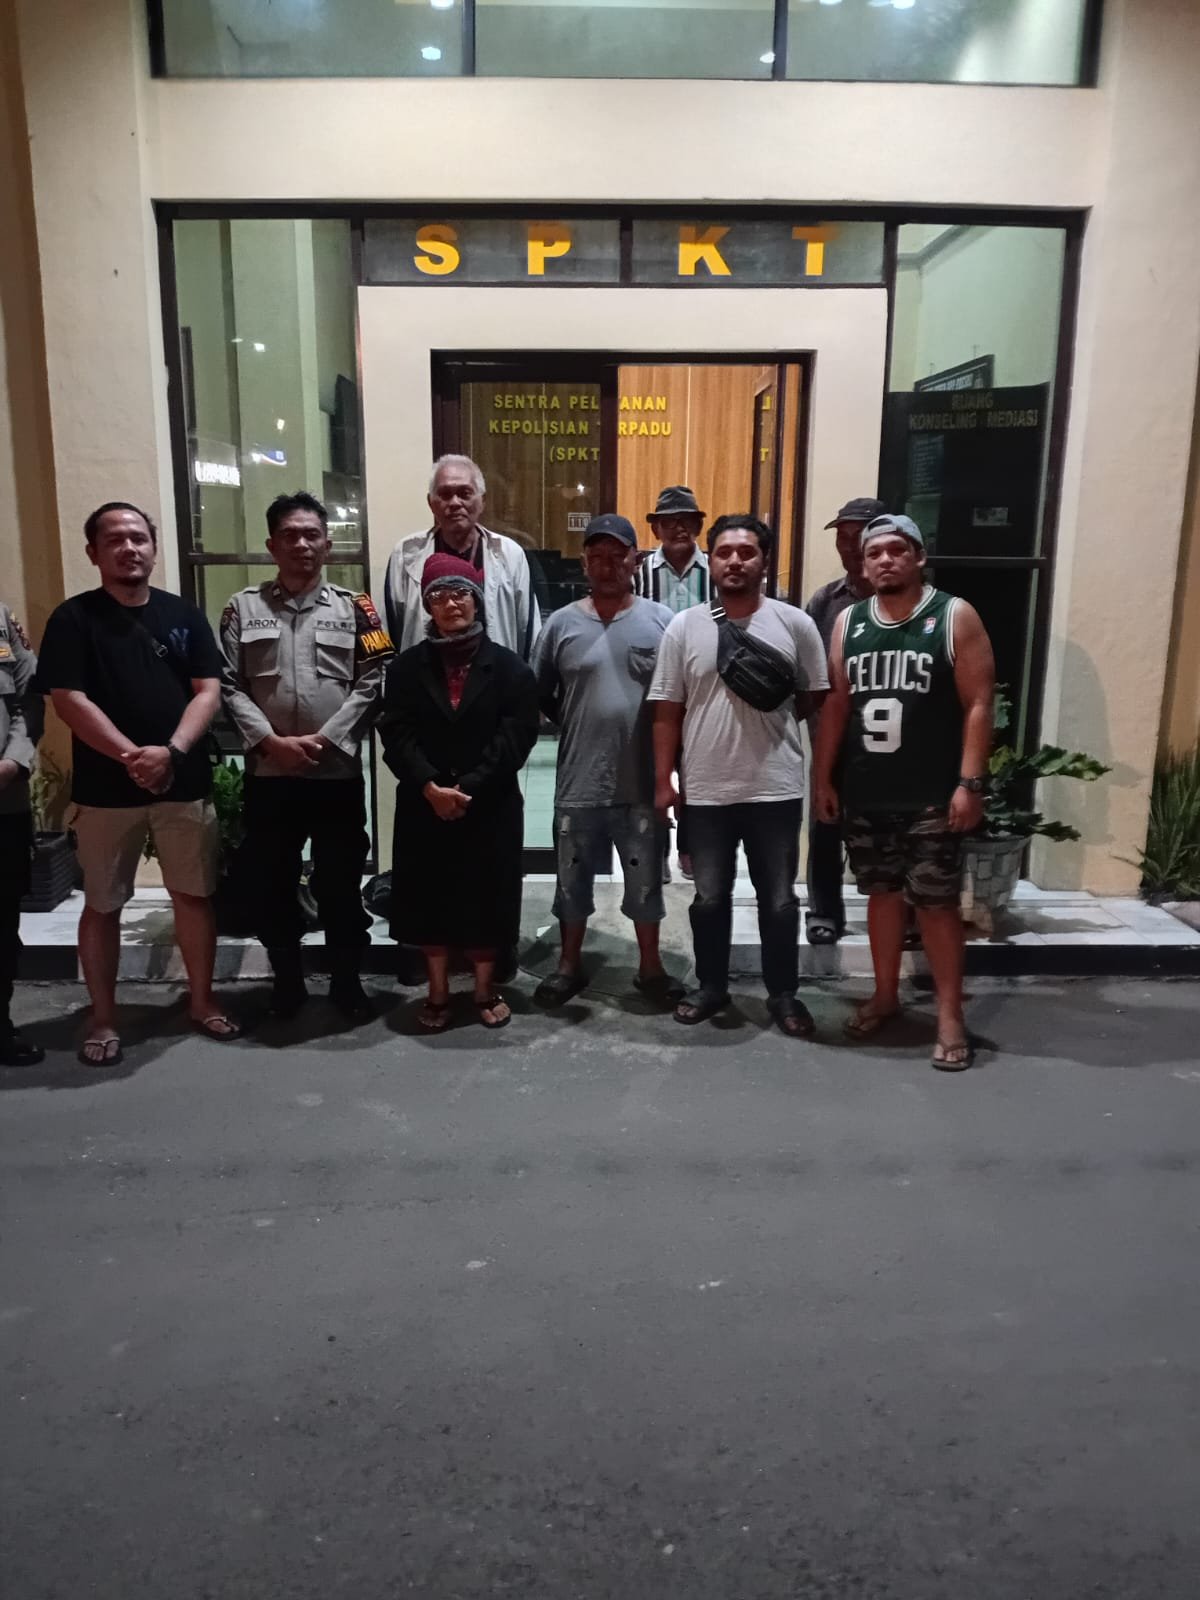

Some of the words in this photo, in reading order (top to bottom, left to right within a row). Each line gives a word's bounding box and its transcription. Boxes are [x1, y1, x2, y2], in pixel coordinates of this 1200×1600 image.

[493, 394, 561, 411] SENTRA
[569, 395, 668, 411] PELANAN
[986, 409, 1039, 428] MEDIASI
[488, 420, 590, 436] KEPOLISIAN
[597, 420, 672, 436] RPADU
[549, 447, 601, 463] (SPKT
[246, 619, 278, 628] ARON
[317, 619, 352, 630] POLRI
[846, 649, 934, 695] CELTICS
[861, 697, 904, 754] 9
